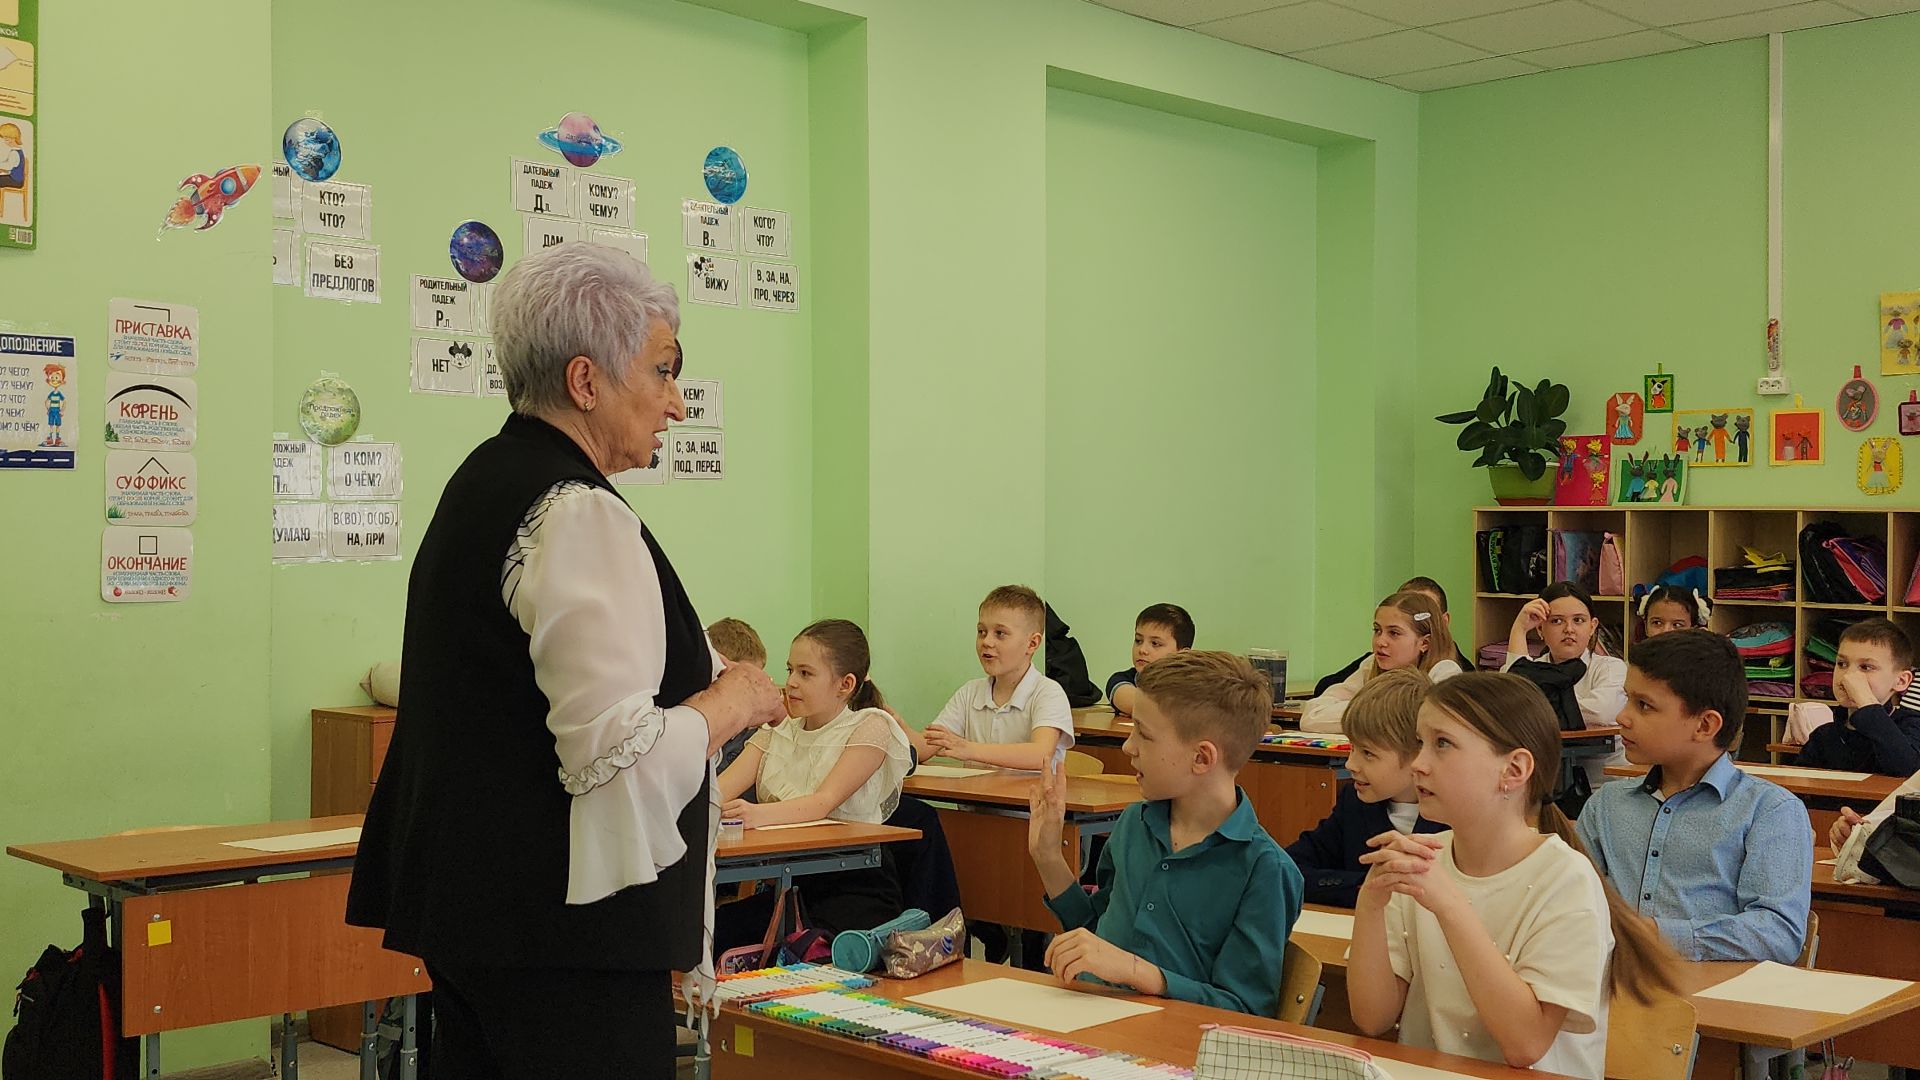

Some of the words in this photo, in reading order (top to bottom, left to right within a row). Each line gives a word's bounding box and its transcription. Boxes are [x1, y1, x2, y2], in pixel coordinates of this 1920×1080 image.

[273, 166, 290, 177] НЫЙ
[523, 164, 560, 178] ДАТЕЛЬНЫЙ
[531, 178, 553, 190] ПАДЕЖ
[589, 183, 619, 200] КОМУ?
[319, 190, 345, 208] КТО?
[589, 203, 619, 219] ЧЕМУ?
[319, 212, 345, 228] ЧТО?
[753, 215, 776, 230] КОГО?
[756, 234, 775, 248] ЧТО?
[334, 254, 354, 270] БЕЗ
[312, 273, 375, 293] ПРЕДЛОГОВ
[419, 279, 468, 292] РОДИТЕЛЬНЫЙ
[705, 276, 729, 291] ВИЖУ
[766, 270, 778, 285] ЗА,
[779, 272, 792, 286] НА,
[431, 293, 456, 305] ПАДЕЖ
[754, 287, 771, 303] ПРО,
[772, 289, 795, 304] ЧЕРЕЗ
[115, 319, 192, 340] ПРИСТАВКА
[0, 336, 63, 353] ОПОЛНЕНИЕ
[9, 367, 29, 376] ЧЕГО?
[432, 358, 450, 373] НЕТ
[11, 381, 33, 390] ЧЕМУ?
[9, 394, 26, 404] ЧТО?
[683, 387, 705, 401] КЕМ?
[6, 408, 25, 417] ЧЕМ?
[120, 401, 178, 420] КОРЕНЬ
[675, 441, 684, 454] С,
[685, 441, 699, 454] ЗА,
[344, 452, 351, 465] О
[353, 452, 382, 465] КОМ?
[674, 460, 694, 474] ПОД,
[695, 460, 722, 474] ПЕРЕД
[116, 475, 187, 490] СУФФИКС
[345, 472, 351, 486] О
[354, 470, 382, 486] ЧЁМ?
[333, 510, 365, 527] В(ВО),
[367, 510, 398, 526] О(ОБ),
[347, 532, 363, 547] НА,
[366, 532, 385, 545] ПРИ
[107, 556, 187, 571] ОКОНЧАНИЕ
